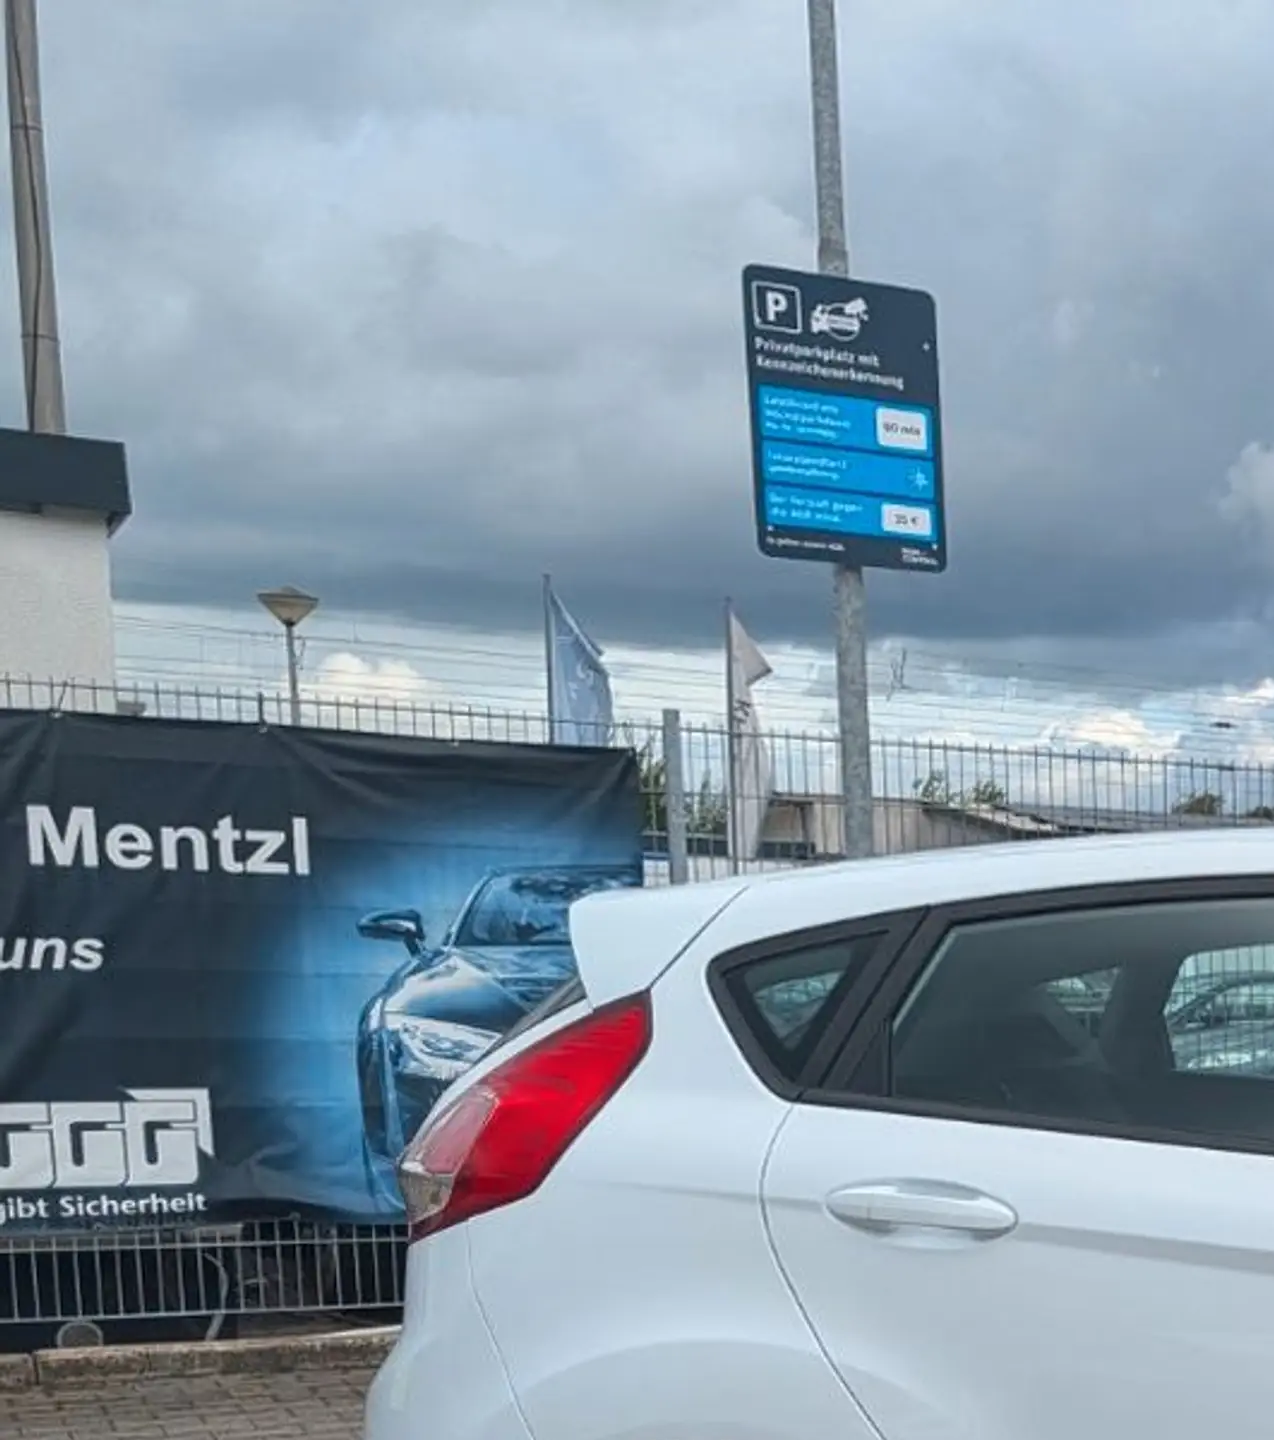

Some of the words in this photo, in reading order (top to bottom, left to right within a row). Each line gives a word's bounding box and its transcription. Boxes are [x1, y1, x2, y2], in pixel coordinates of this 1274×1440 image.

[766, 290, 788, 322] P
[857, 354, 880, 368] mit
[26, 804, 310, 876] Mentzl
[0, 936, 104, 971] uns
[60, 1192, 208, 1218] Sicherheit
